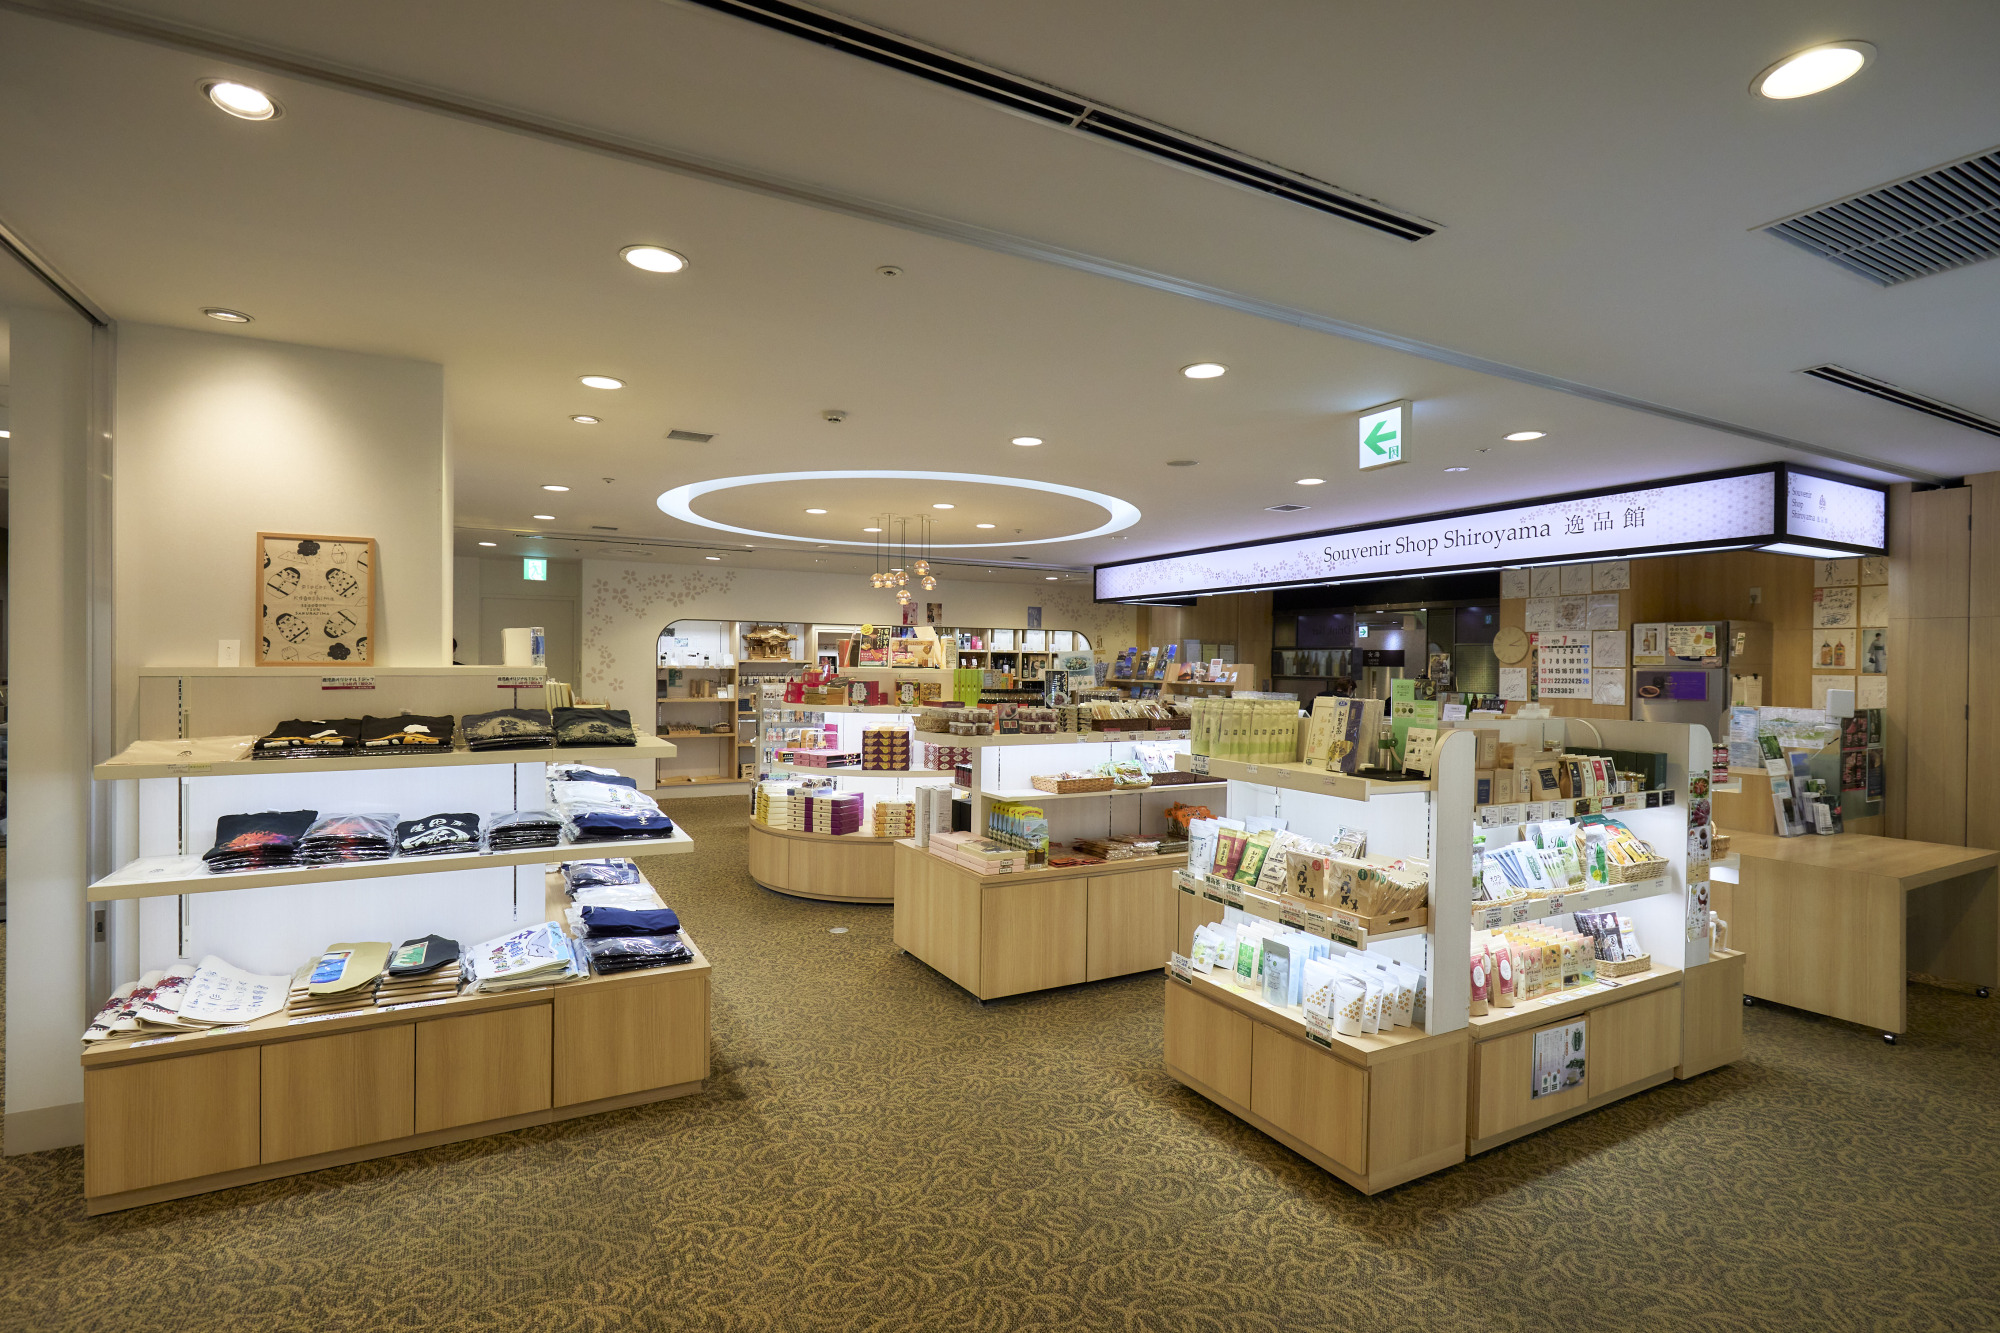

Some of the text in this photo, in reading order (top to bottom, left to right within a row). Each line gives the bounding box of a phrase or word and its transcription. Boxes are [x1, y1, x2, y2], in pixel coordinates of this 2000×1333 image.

[1791, 486, 1812, 499] Souvenir
[1791, 498, 1804, 511] Shop
[1791, 509, 1816, 522] Shiroyama
[1323, 506, 1646, 563] Souvenir Shop Shiroyama 逸品館
[1562, 635, 1568, 646] 7
[1226, 881, 1242, 892] 知覧茶
